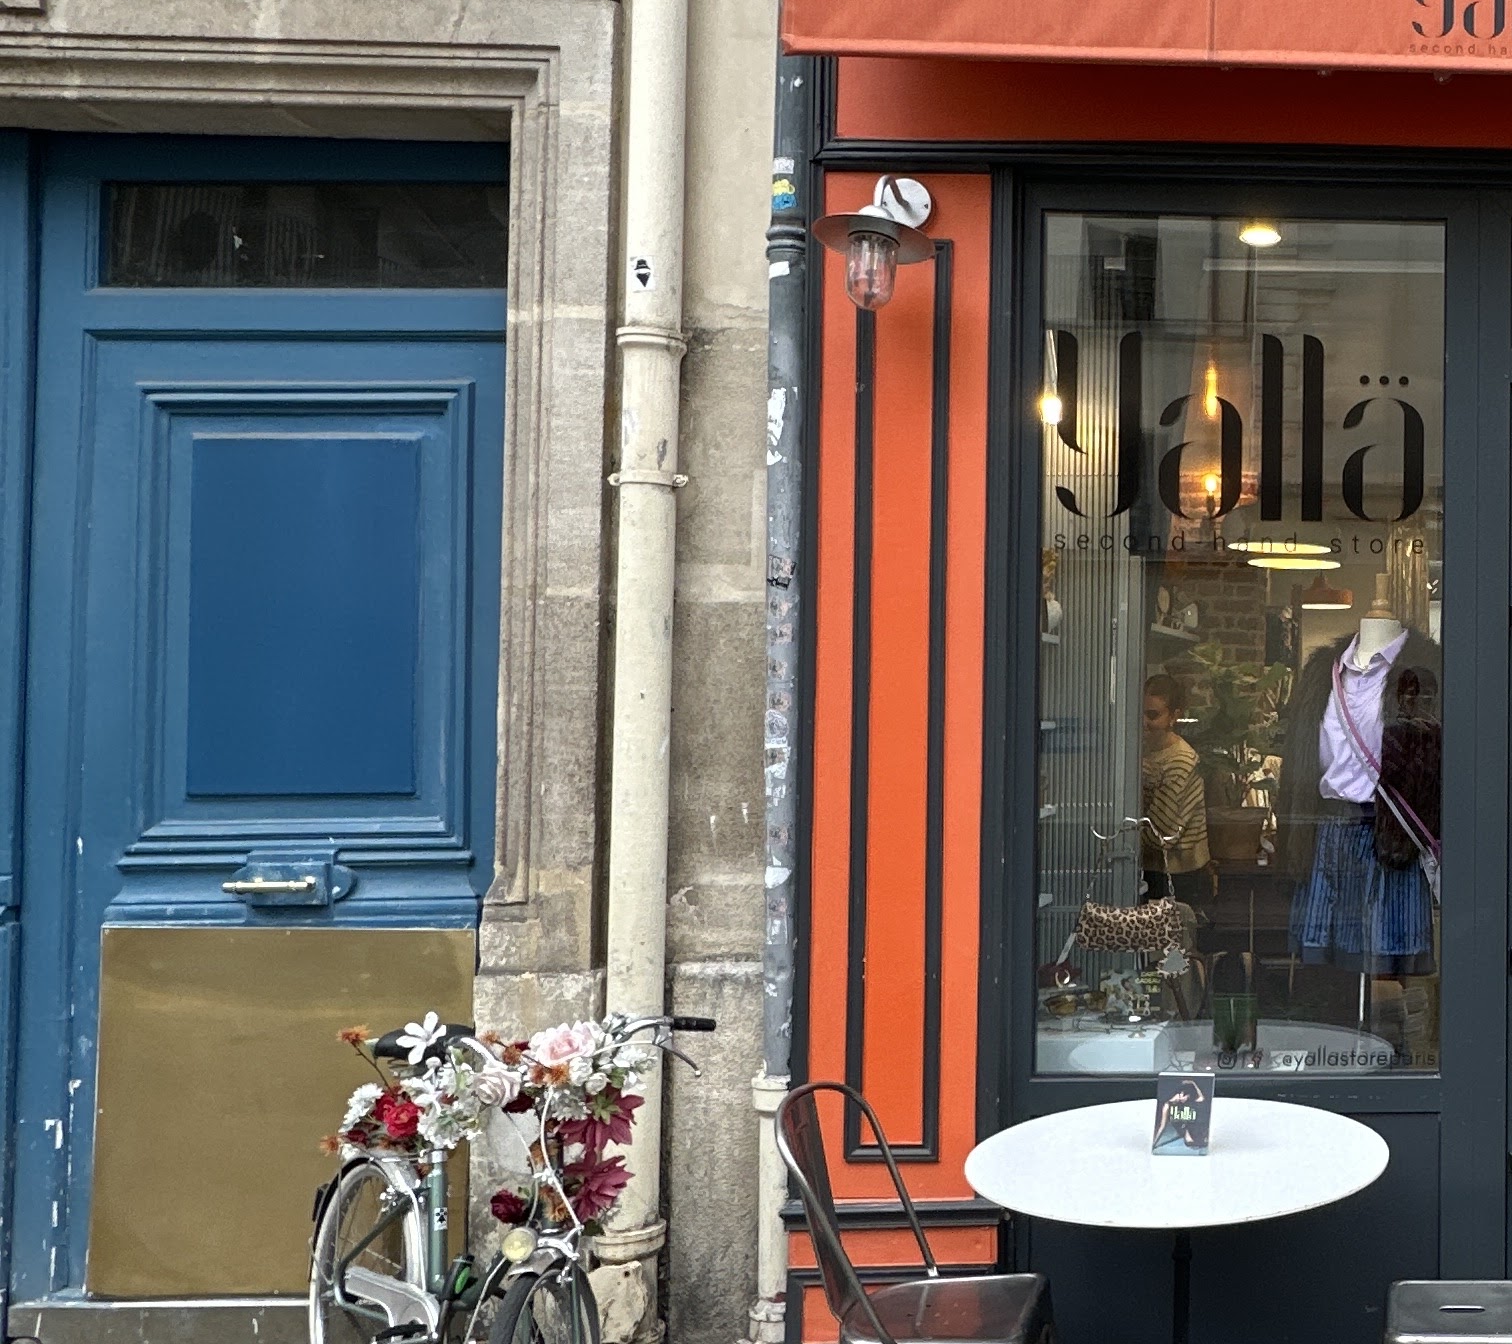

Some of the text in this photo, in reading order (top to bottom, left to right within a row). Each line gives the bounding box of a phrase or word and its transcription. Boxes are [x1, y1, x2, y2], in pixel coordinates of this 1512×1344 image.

[1409, 43, 1476, 54] second
[1330, 534, 1425, 555] store
[1282, 1045, 1437, 1071] @yallastoreparis
